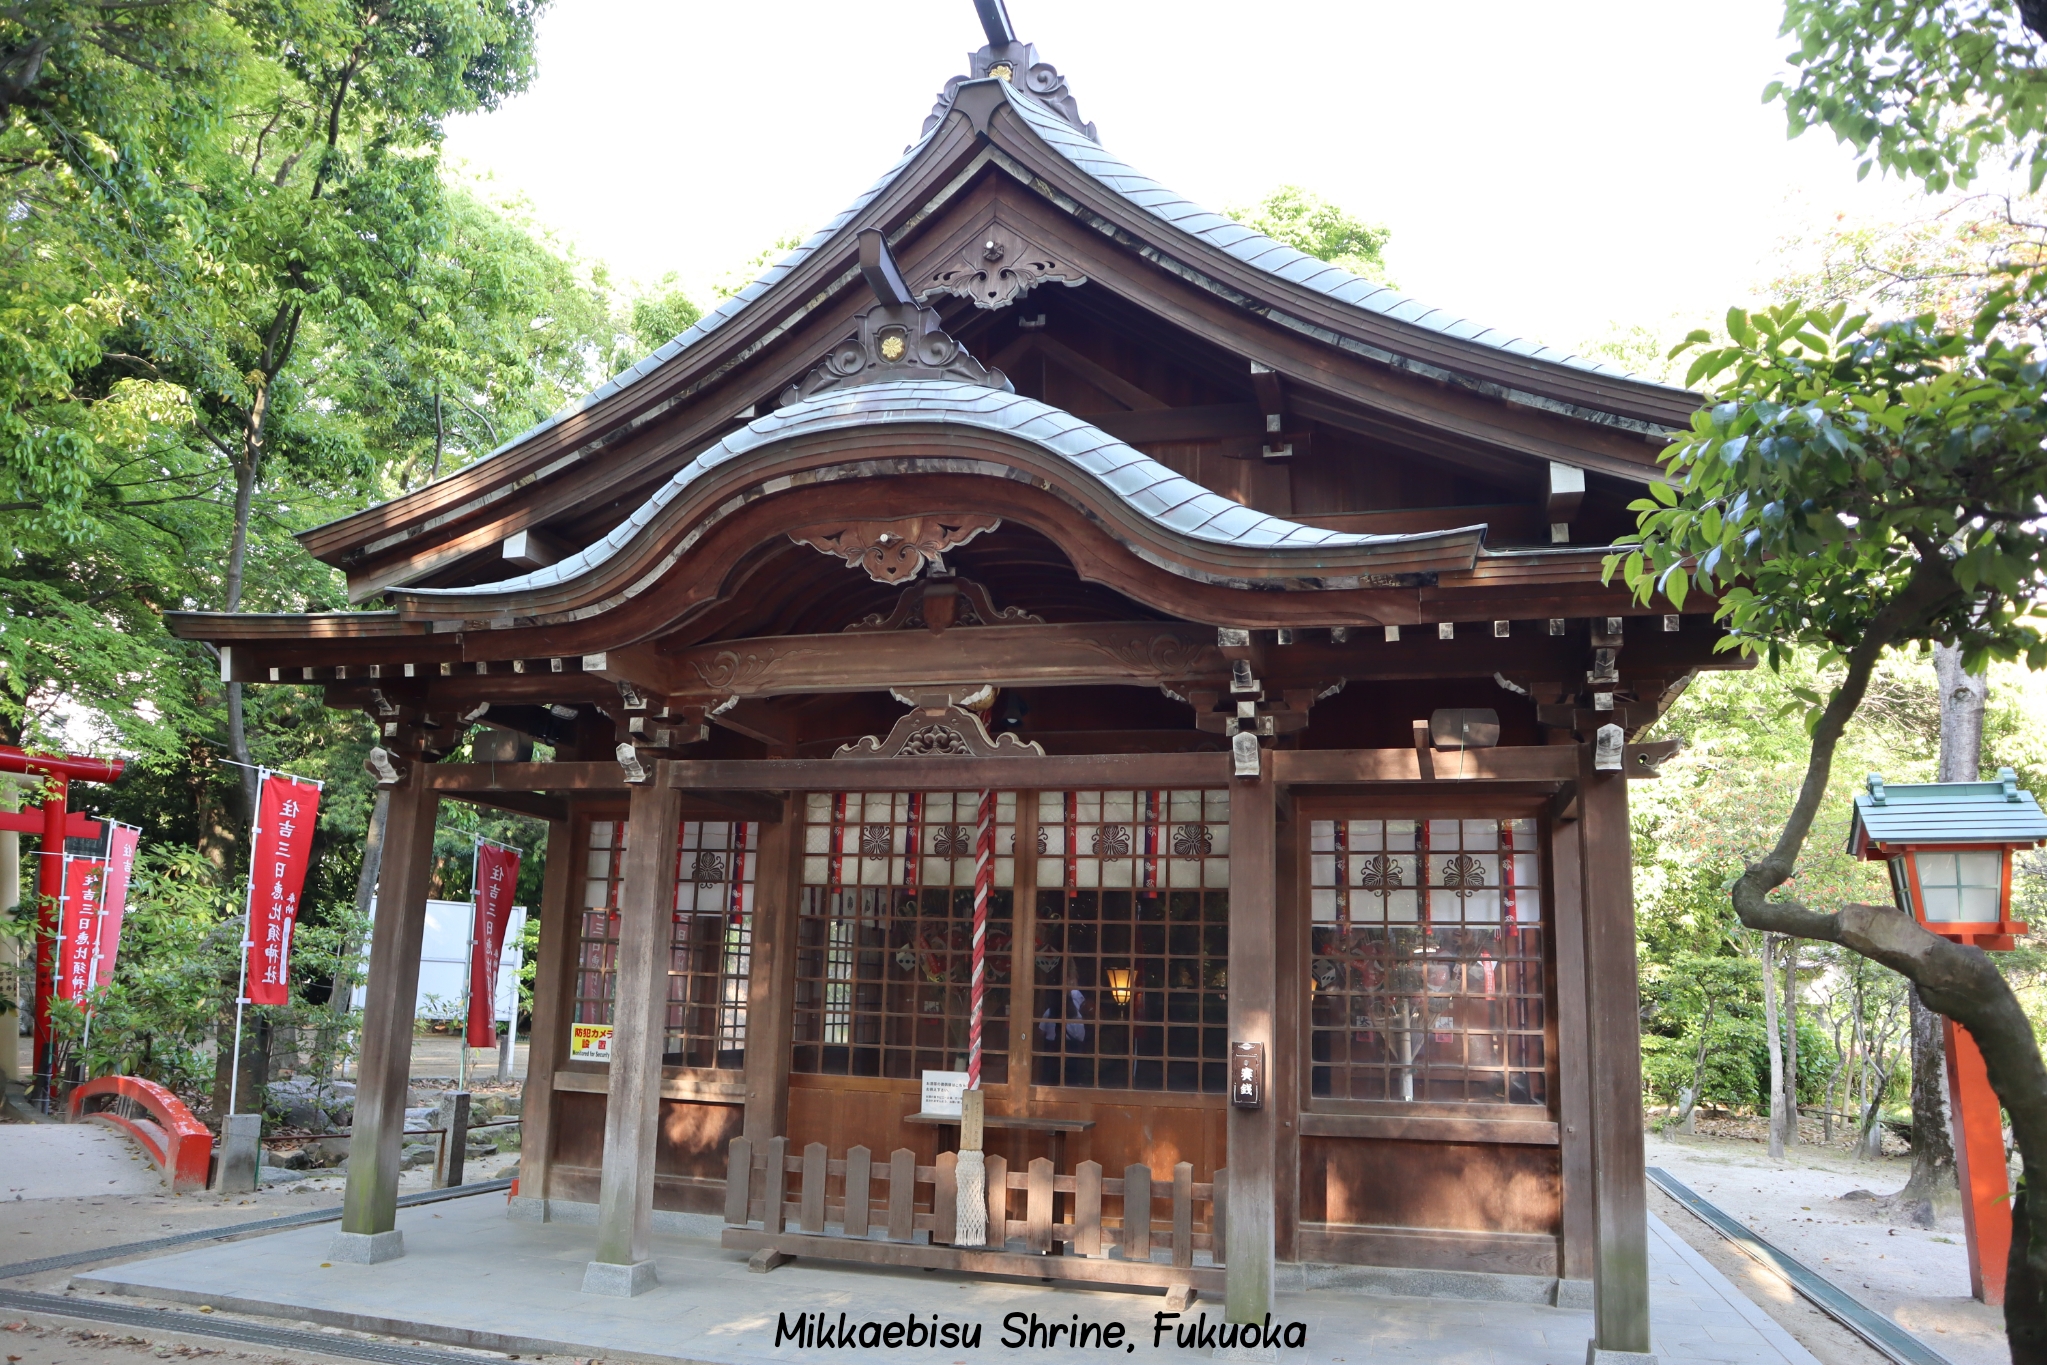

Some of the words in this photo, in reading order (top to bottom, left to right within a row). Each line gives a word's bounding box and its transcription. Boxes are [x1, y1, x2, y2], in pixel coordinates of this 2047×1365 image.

[574, 1027, 613, 1039] 防犯カメラ
